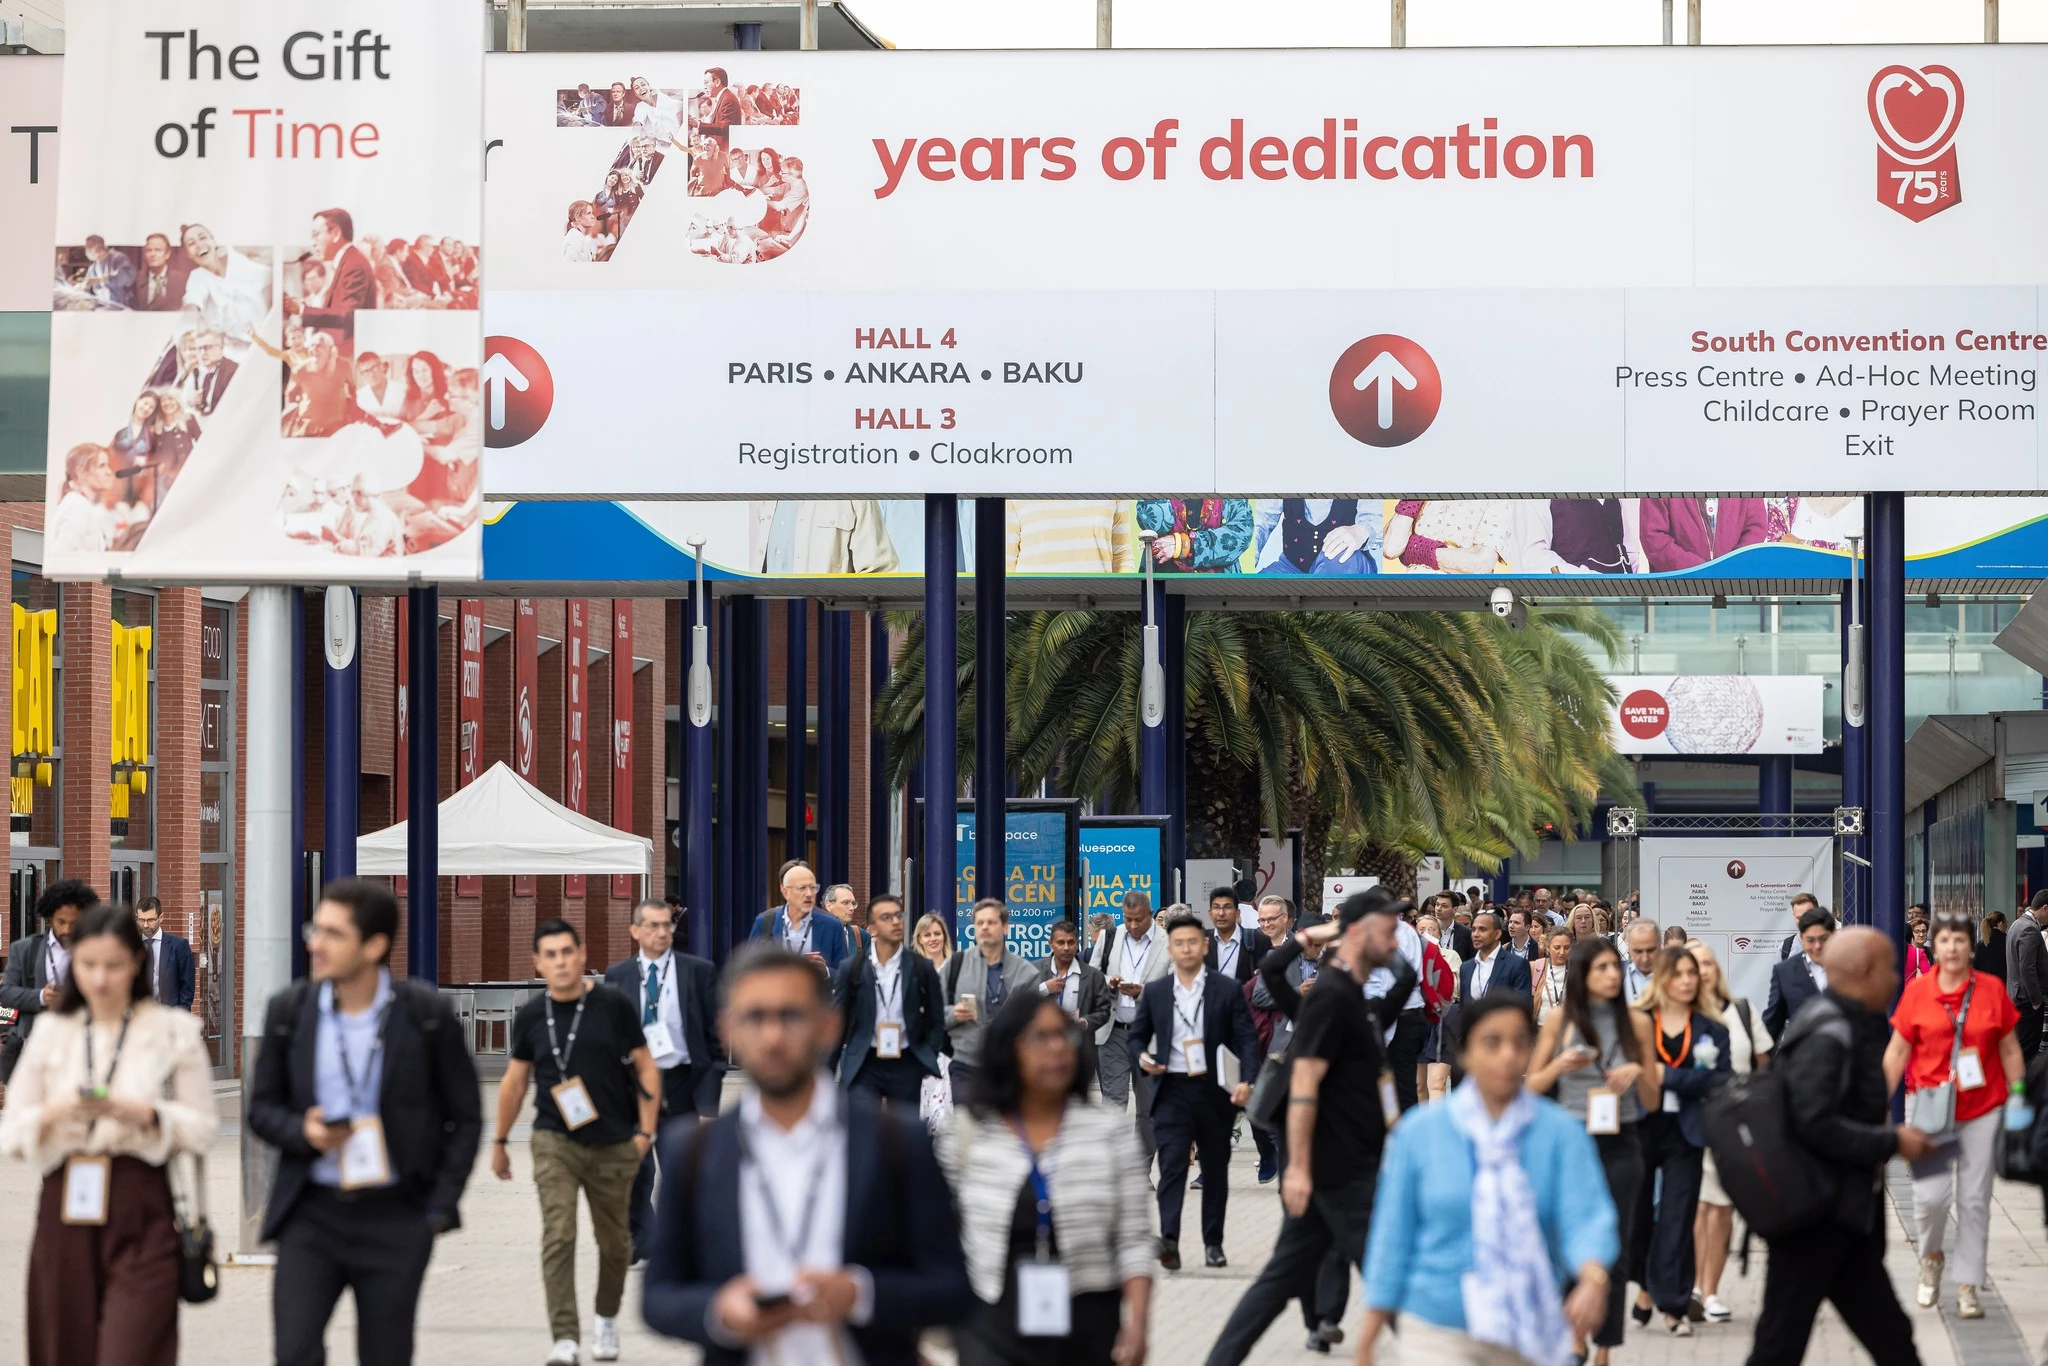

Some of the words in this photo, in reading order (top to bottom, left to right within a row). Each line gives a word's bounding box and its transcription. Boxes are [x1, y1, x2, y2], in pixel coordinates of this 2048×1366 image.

[144, 28, 260, 81] The
[282, 29, 391, 81] Gift
[154, 106, 216, 159] of
[232, 108, 380, 159] Time
[872, 137, 1076, 200] years
[1101, 119, 1179, 181] of
[1199, 117, 1594, 181] dedication
[1890, 171, 1938, 204] 75
[1940, 170, 1949, 198] years
[856, 328, 931, 349] HALL
[941, 328, 957, 349] 4
[1691, 330, 1776, 352] South
[1785, 329, 1944, 352] Convention
[1956, 329, 2048, 352] Centre
[729, 362, 812, 383] PARIS
[845, 362, 971, 383] ANKARA
[1004, 361, 1083, 383] BAKU
[1616, 366, 1687, 387] Press
[1698, 366, 1784, 387] Centre
[1816, 364, 1919, 387] Ad-Hoc
[1930, 364, 2037, 393] Meeting
[855, 408, 931, 429] HALL
[940, 408, 956, 429] 3
[1704, 399, 1828, 422] Childcare
[1862, 400, 1949, 427] Prayer
[1959, 399, 2034, 420] Room
[739, 443, 897, 470] Registration
[931, 442, 1072, 464] Cloakroom
[1845, 434, 1894, 456] Exit
[204, 626, 221, 659] FOOD
[11, 602, 57, 757] EAT
[111, 619, 152, 765] EAT
[1624, 707, 1647, 715] SAVE
[1648, 707, 1665, 715] THE
[200, 703, 221, 748] KET
[969, 830, 1038, 842] bpace
[1031, 866, 1055, 881] TU
[1129, 875, 1151, 888] TU
[1023, 908, 1040, 917] 200
